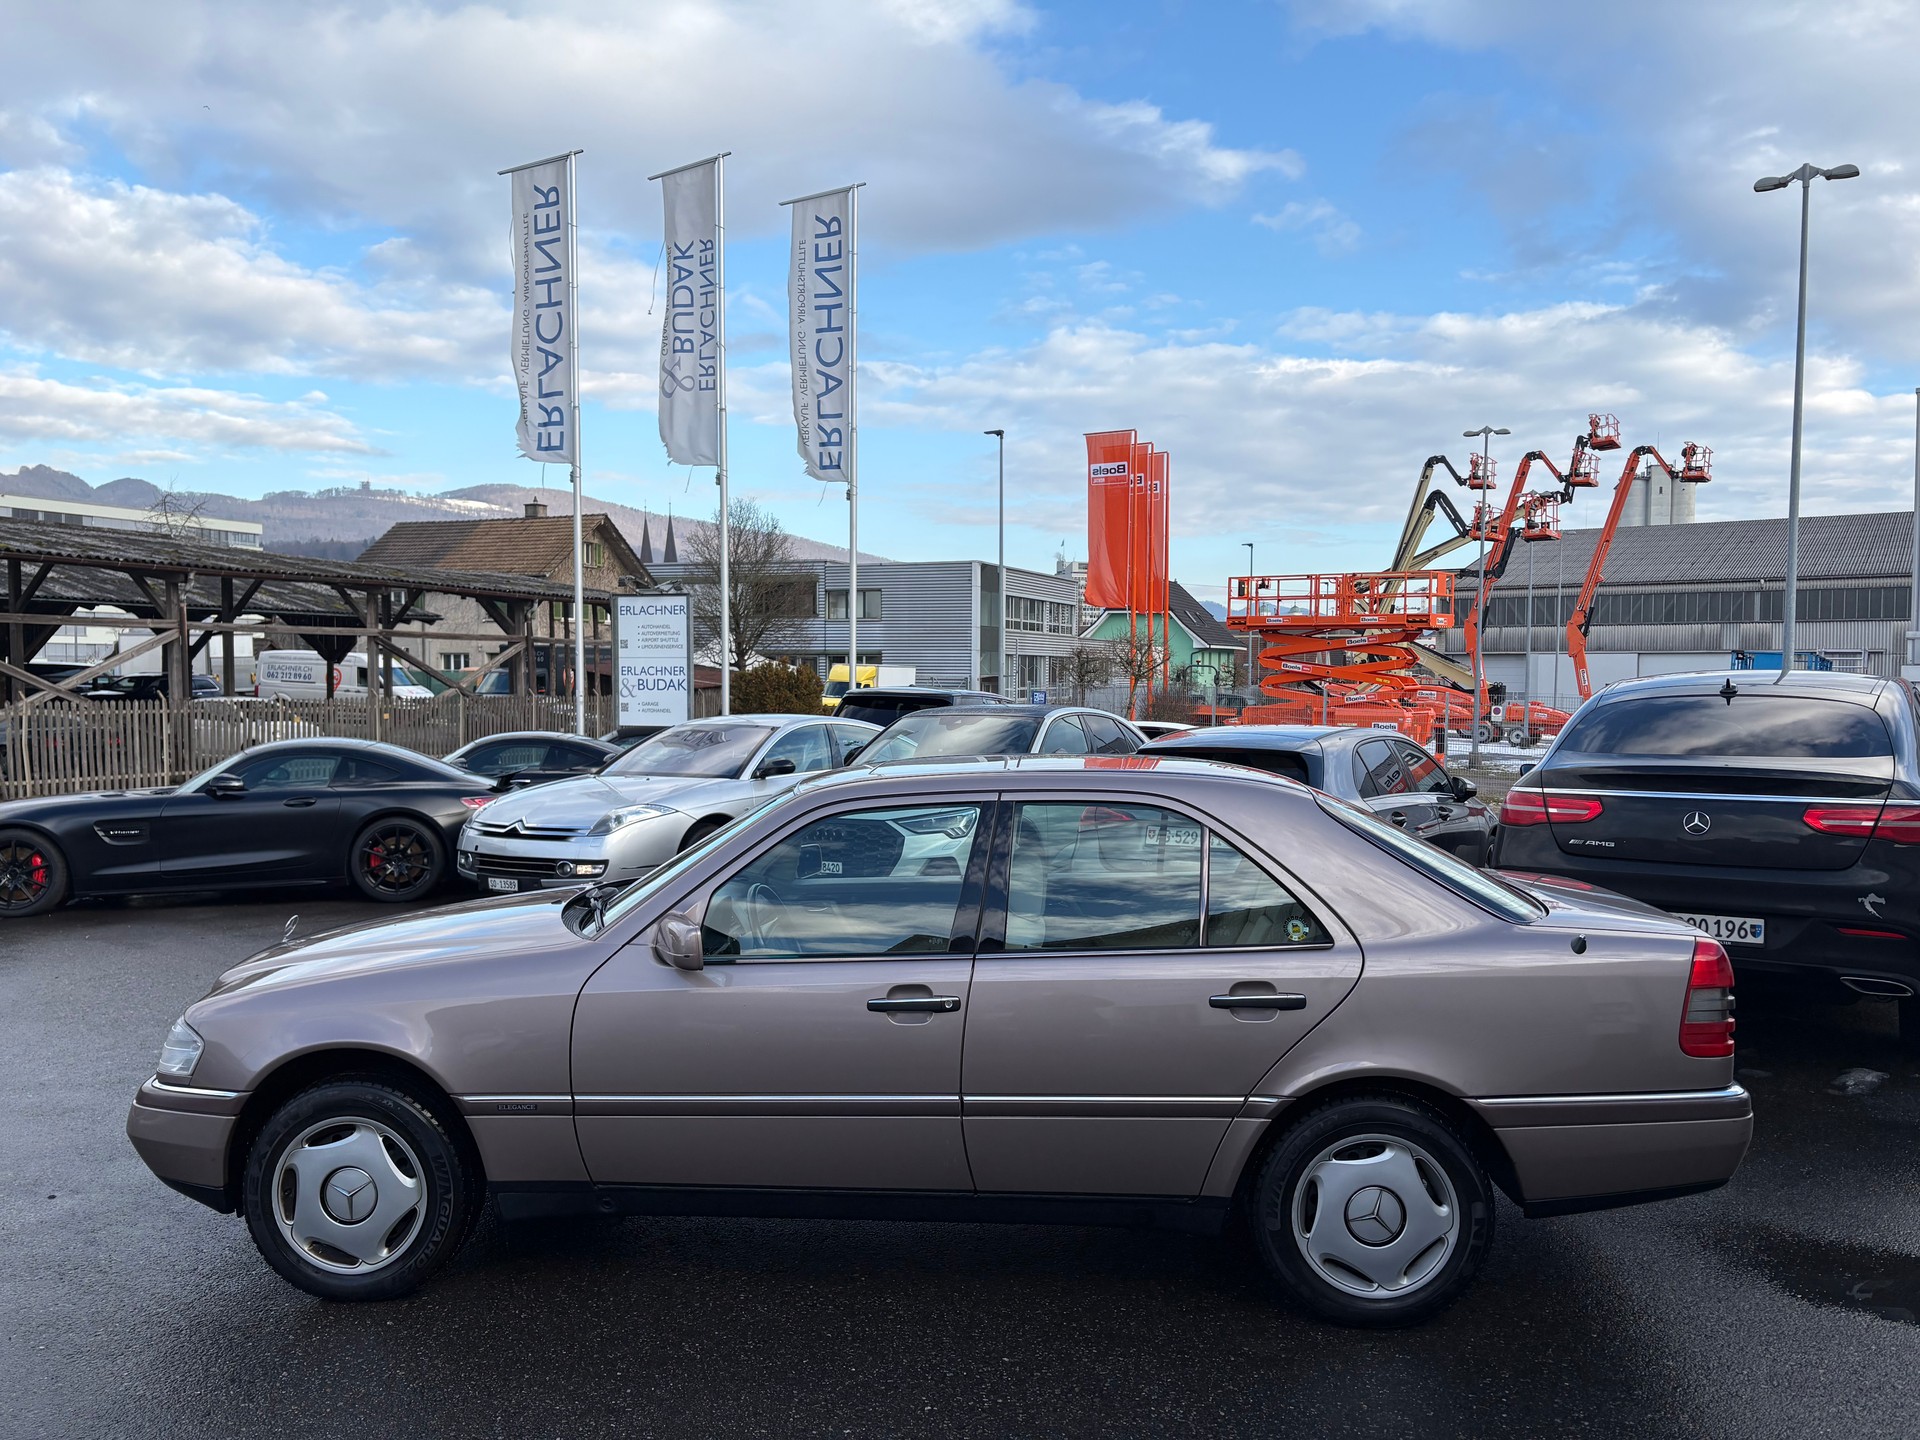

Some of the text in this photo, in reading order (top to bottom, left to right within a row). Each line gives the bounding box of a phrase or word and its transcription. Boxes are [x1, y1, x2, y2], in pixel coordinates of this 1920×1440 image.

[619, 604, 687, 616] ERLACHNER
[267, 671, 279, 679] 062
[280, 672, 291, 680] 212
[620, 665, 686, 676] ERLACHNER
[620, 677, 687, 698] & BUDAK
[1713, 919, 1749, 939] 196
[409, 1150, 455, 1270] WINGUARD
